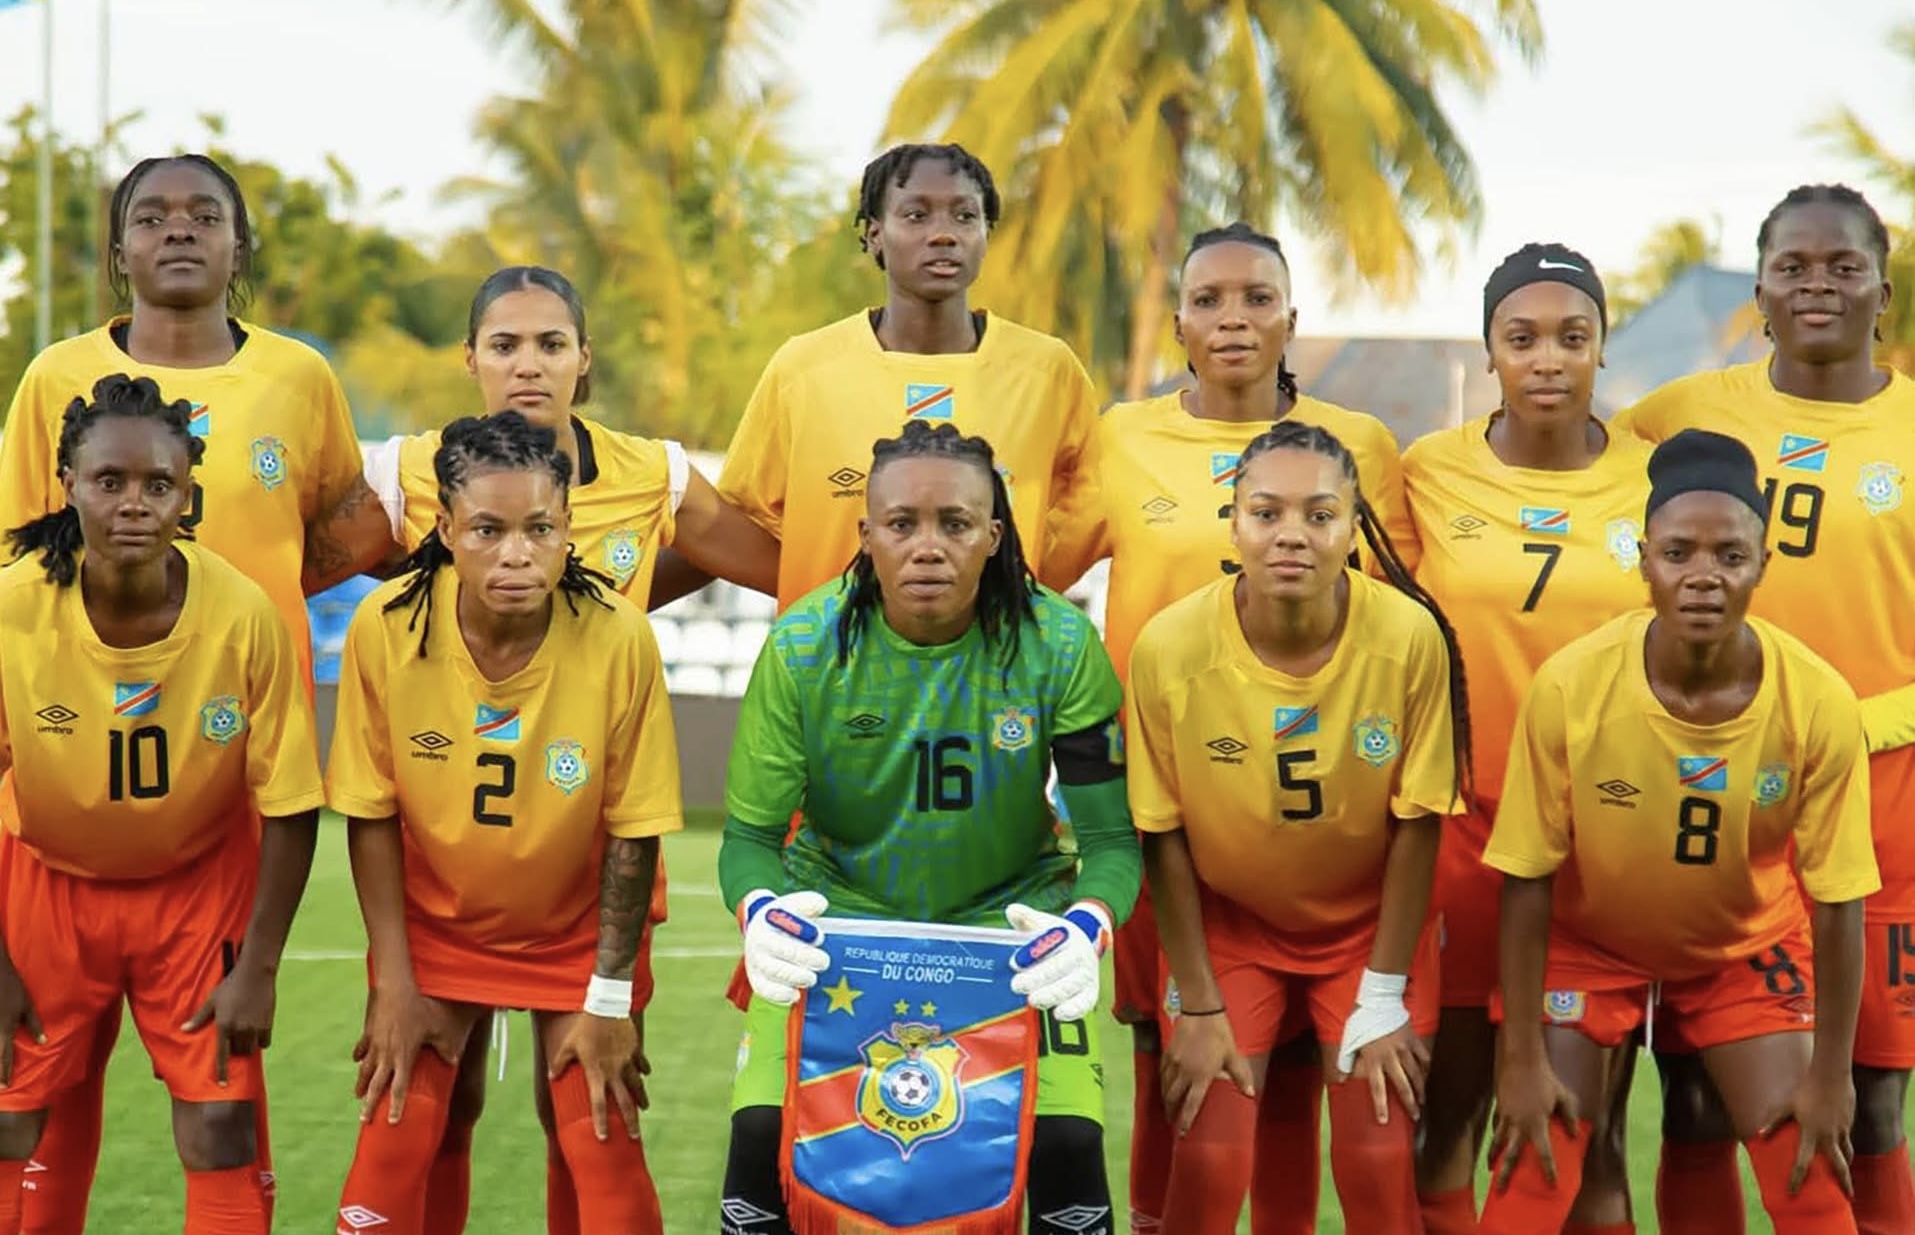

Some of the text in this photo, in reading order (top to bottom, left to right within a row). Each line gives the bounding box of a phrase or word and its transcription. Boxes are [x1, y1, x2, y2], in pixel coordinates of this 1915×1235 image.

[1763, 477, 1826, 559] 19
[1522, 543, 1563, 612] 7
[109, 725, 169, 801] 10
[473, 752, 516, 828] 2
[914, 736, 973, 812] 16
[1277, 749, 1324, 820] 5
[1674, 796, 1722, 865] 8
[882, 964, 954, 984] DU CONGO
[876, 1108, 943, 1132] FECOFA
